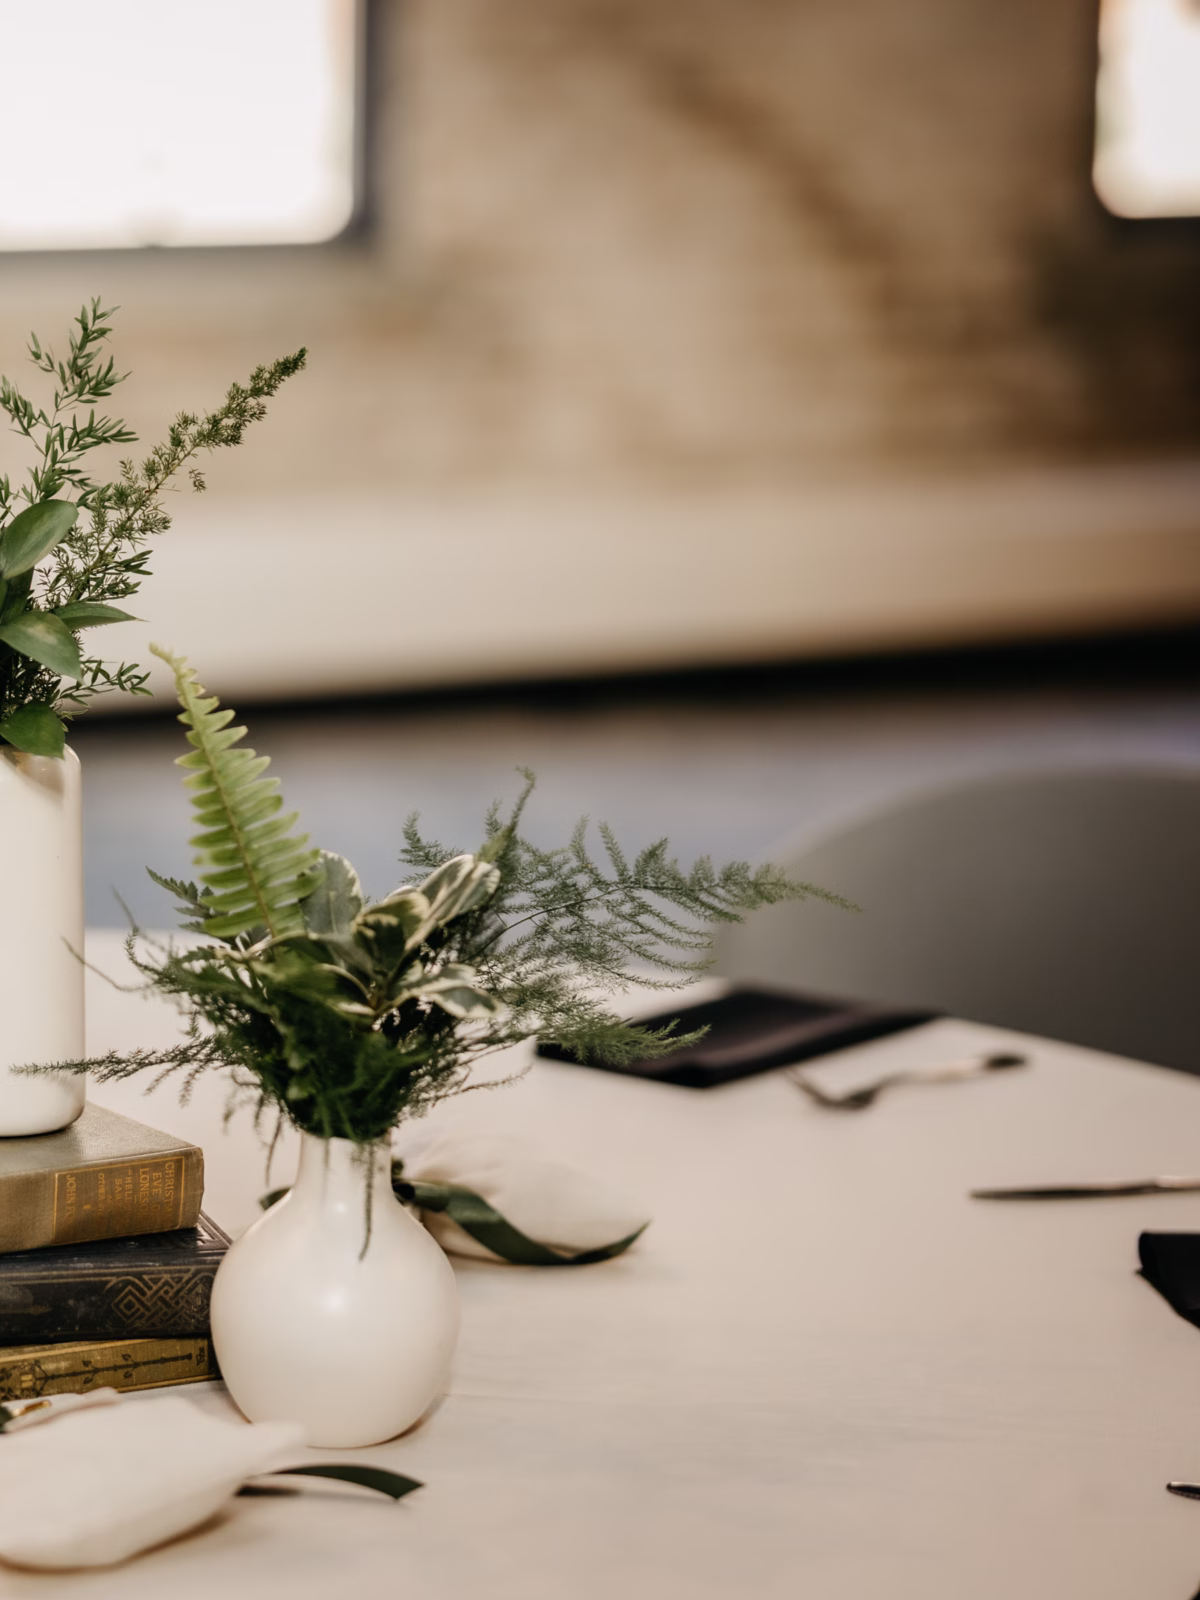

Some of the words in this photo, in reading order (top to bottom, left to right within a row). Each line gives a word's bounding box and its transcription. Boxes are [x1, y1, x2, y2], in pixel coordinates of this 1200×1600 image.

[66, 1174, 76, 1204] JOHN
[139, 1167, 149, 1213] LONESO
[152, 1171, 163, 1196] EVE
[164, 1161, 175, 1213] CHRISTM
